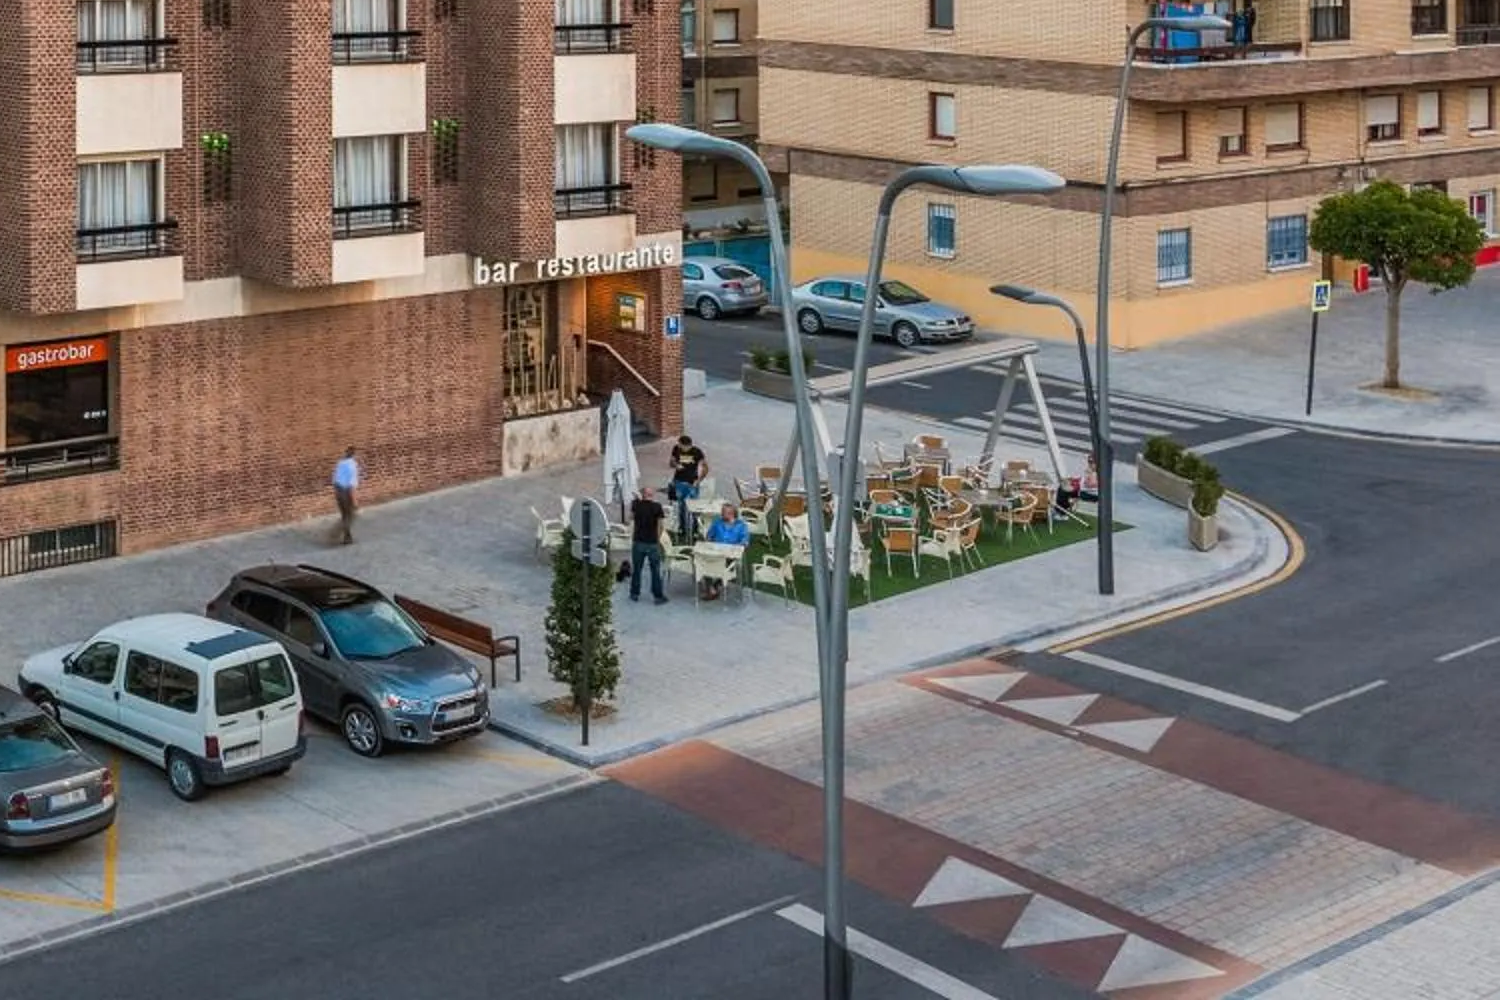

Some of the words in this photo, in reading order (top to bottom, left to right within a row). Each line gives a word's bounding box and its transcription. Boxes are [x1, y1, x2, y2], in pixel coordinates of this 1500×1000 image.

[474, 256, 520, 285] bar
[536, 240, 675, 279] restaurante
[17, 343, 95, 370] gastrobar
